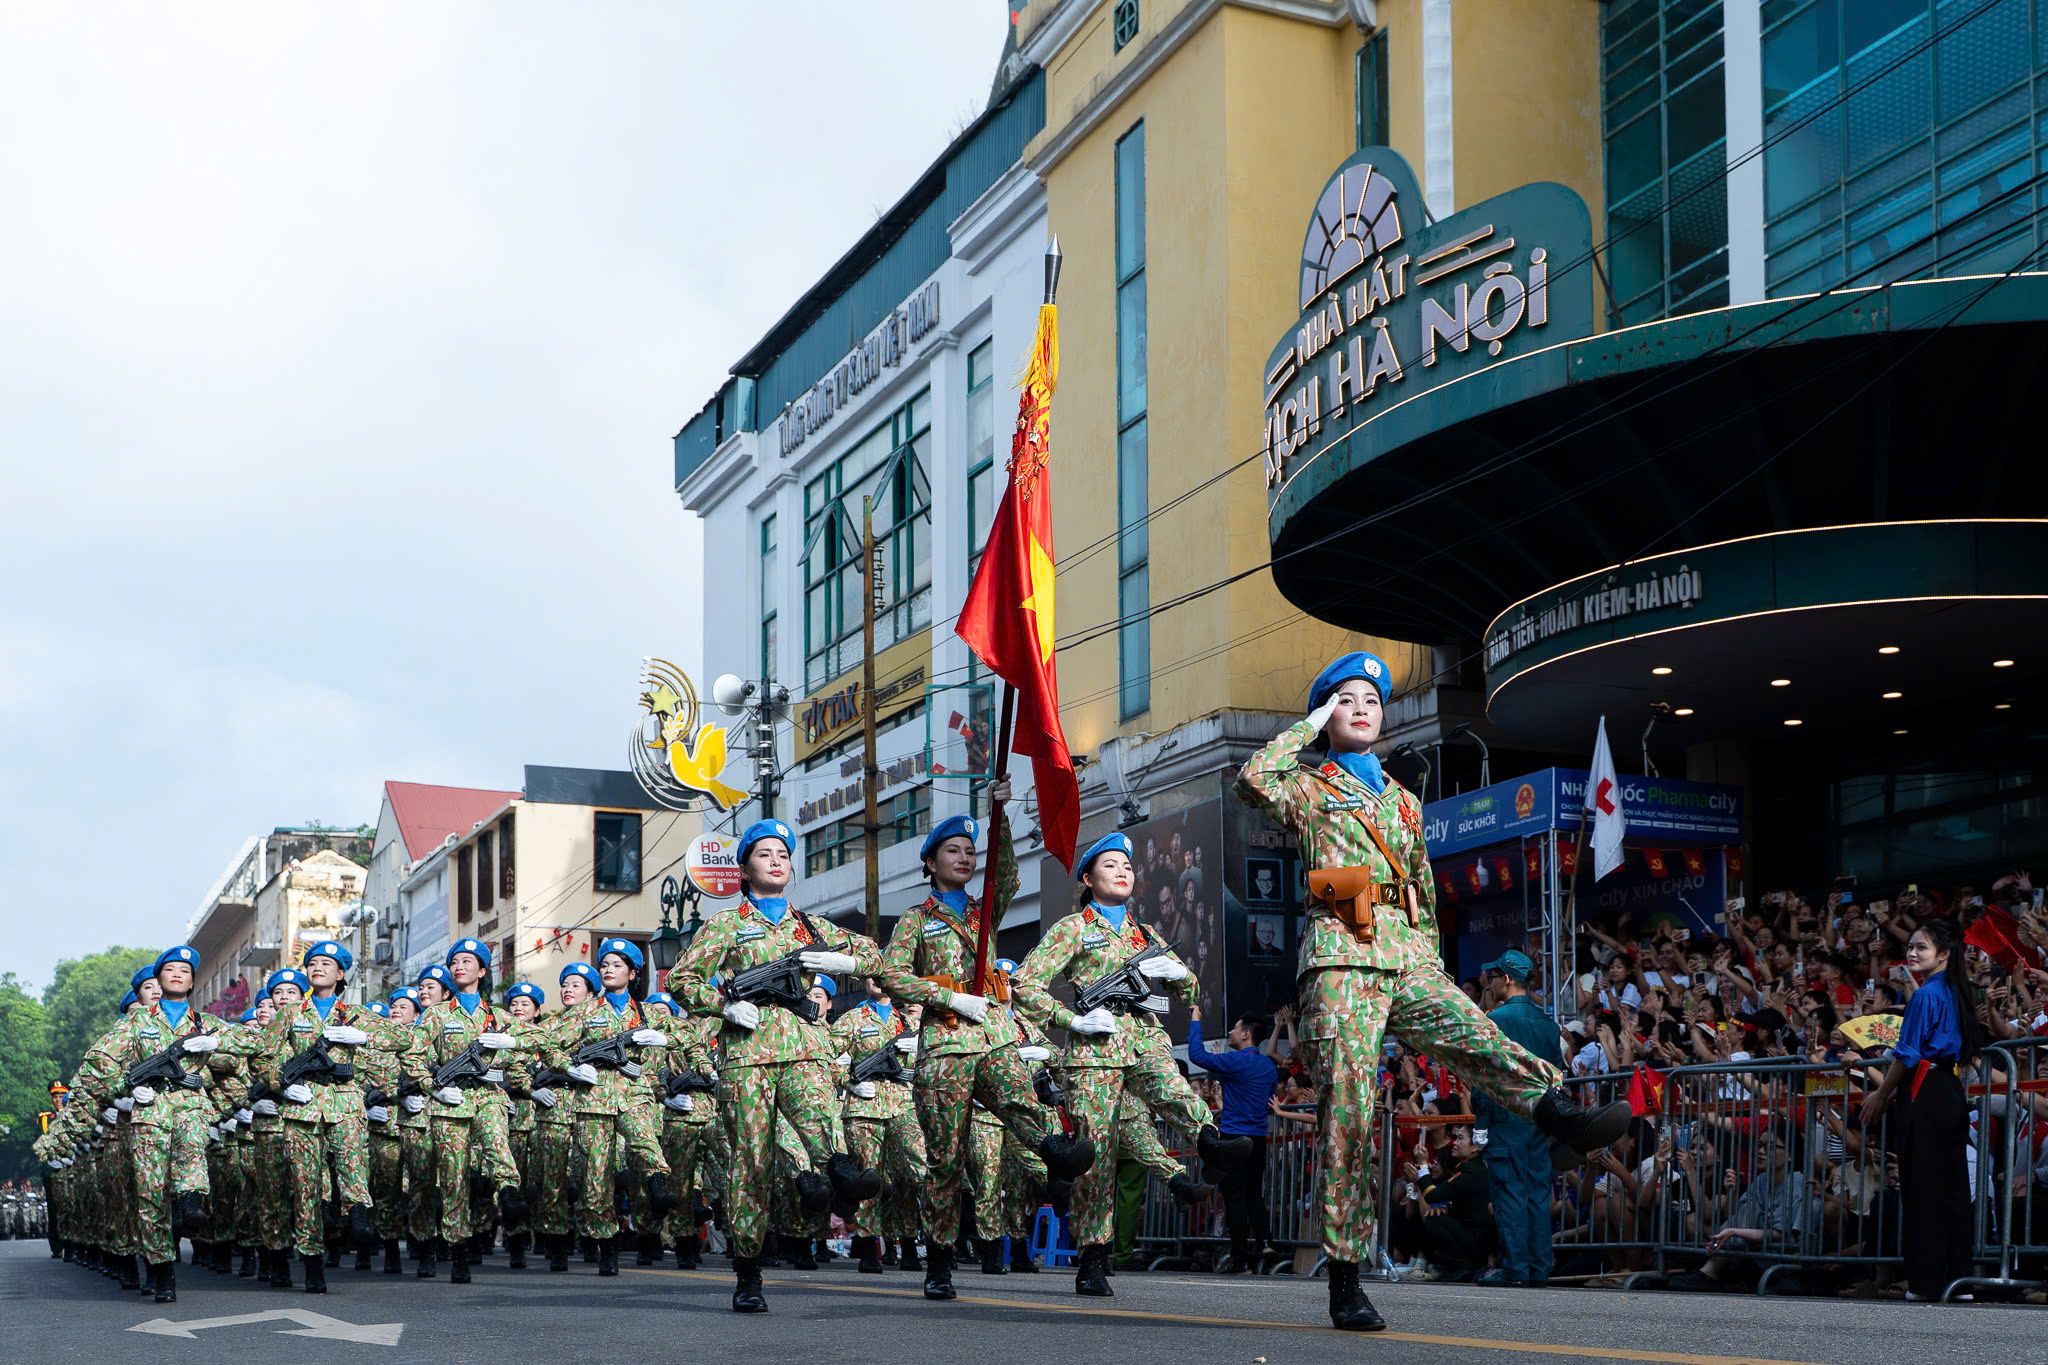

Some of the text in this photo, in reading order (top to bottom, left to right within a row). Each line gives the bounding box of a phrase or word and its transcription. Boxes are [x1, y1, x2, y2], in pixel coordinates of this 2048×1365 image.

[1297, 254, 1412, 368] NHÀ HÁT
[1329, 316, 1405, 420] HÀ
[1663, 564, 1700, 608] NỘI
[1648, 786, 1738, 815] Pharmacity
[701, 841, 721, 853] HD
[702, 853, 735, 866] Bank
